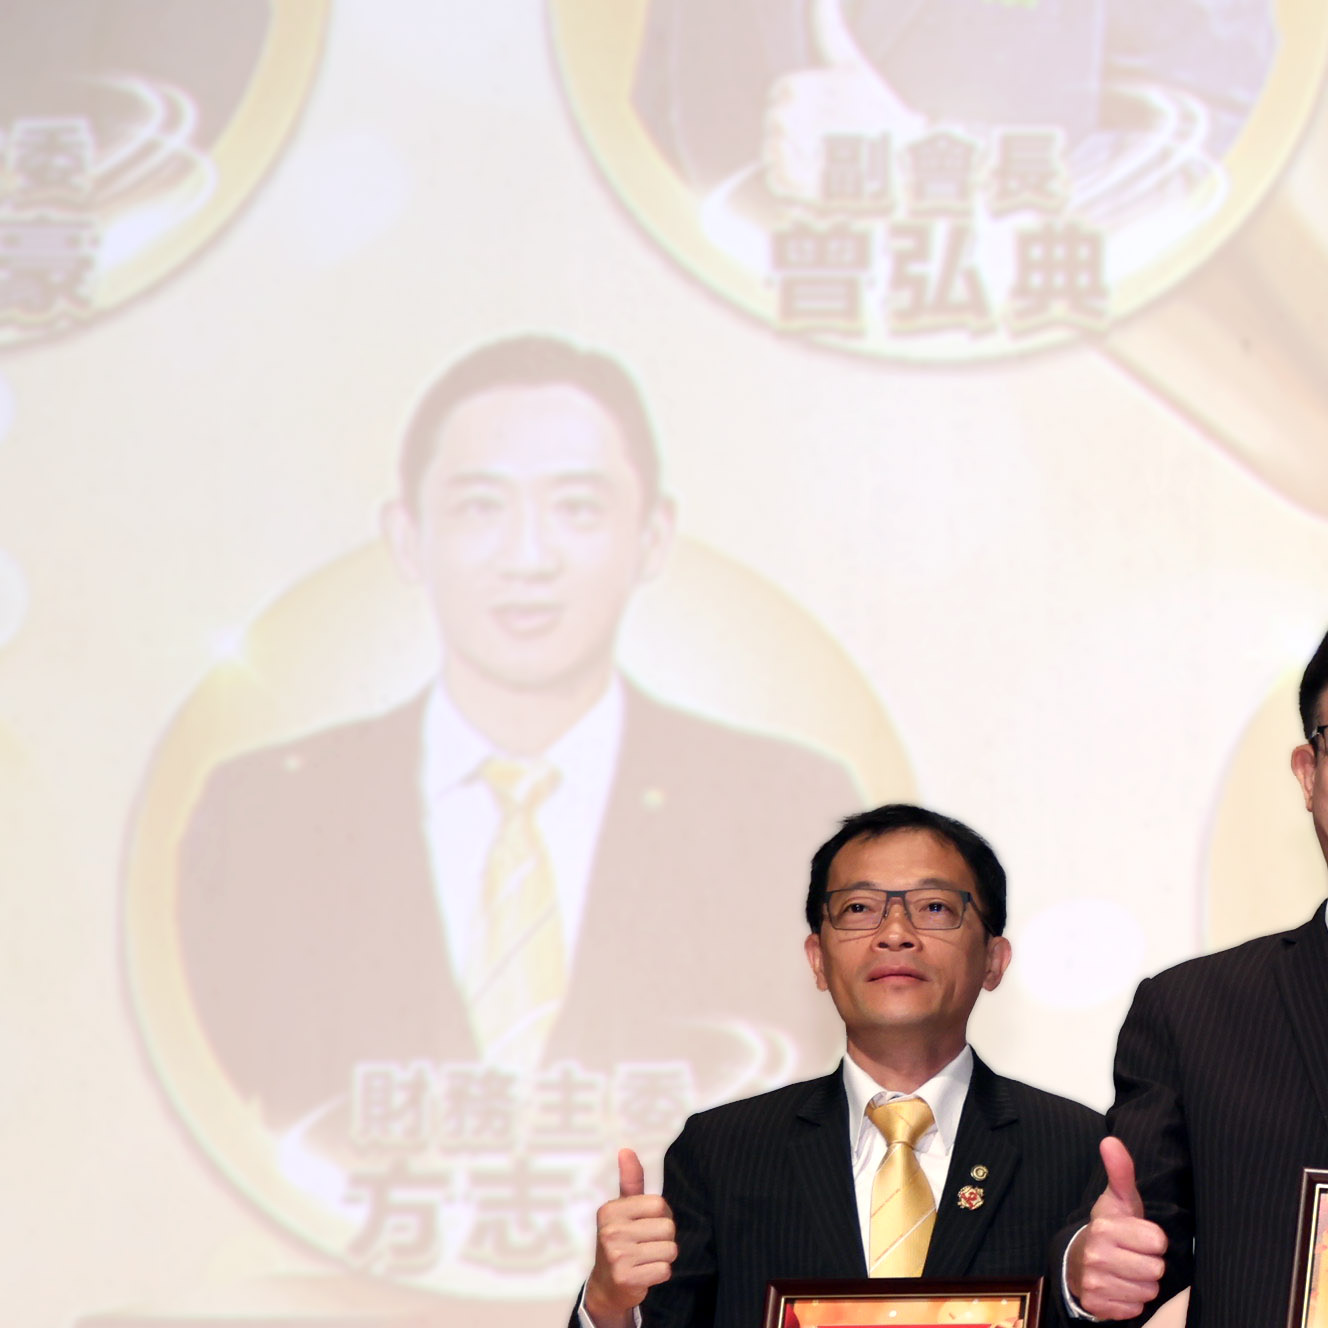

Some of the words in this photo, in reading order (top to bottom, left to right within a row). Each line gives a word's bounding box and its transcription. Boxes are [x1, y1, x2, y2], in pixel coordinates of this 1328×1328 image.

[818, 130, 1064, 214] 副會長
[770, 219, 1110, 331] 曾弘典
[356, 1066, 690, 1150] 財務主委
[346, 1155, 662, 1272] 方志
